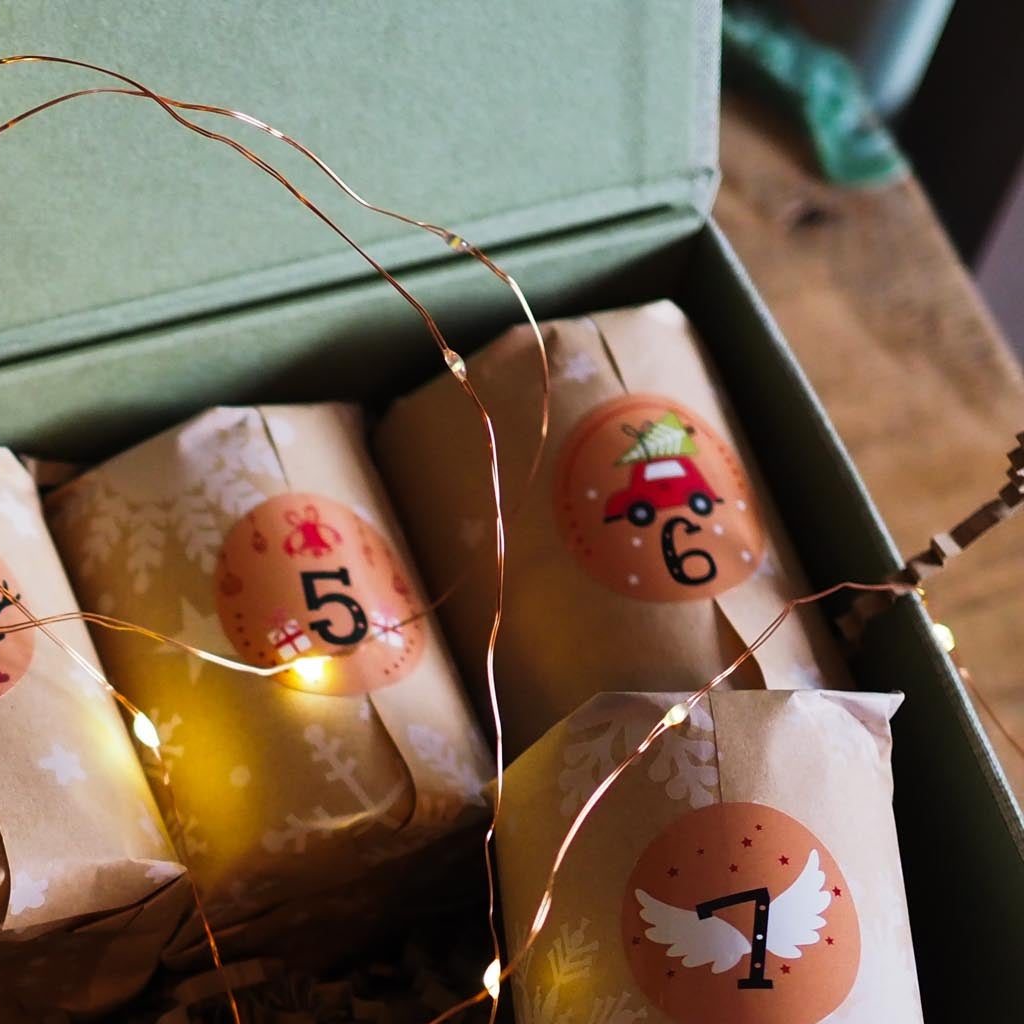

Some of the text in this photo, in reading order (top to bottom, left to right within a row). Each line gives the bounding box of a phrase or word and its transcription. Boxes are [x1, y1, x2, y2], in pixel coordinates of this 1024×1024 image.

[660, 516, 718, 587] 6
[299, 566, 369, 646] 5
[695, 887, 774, 990] 7
